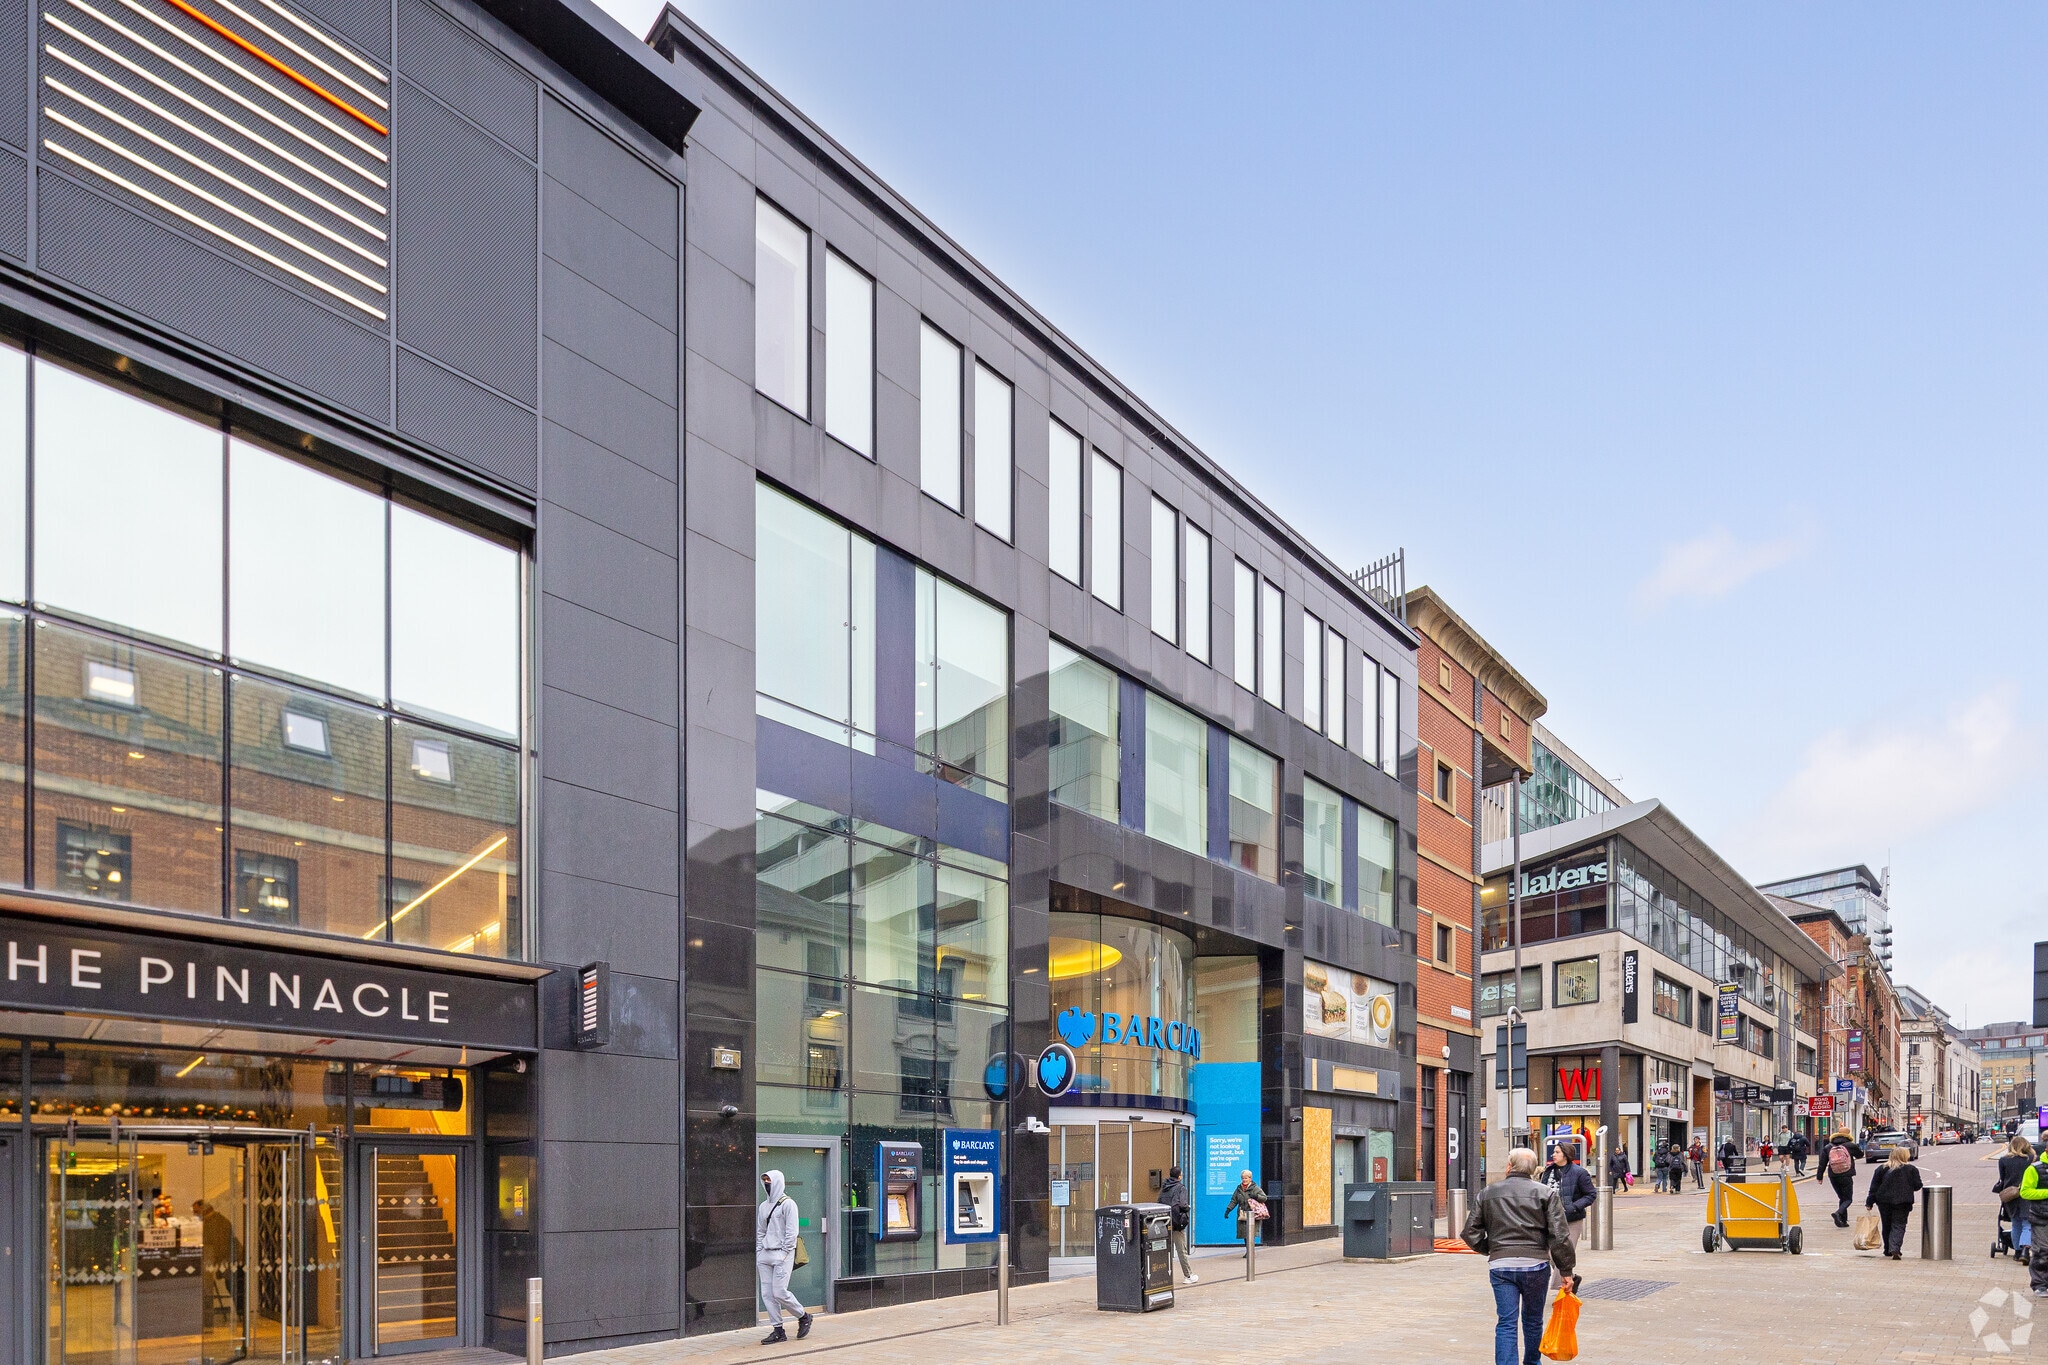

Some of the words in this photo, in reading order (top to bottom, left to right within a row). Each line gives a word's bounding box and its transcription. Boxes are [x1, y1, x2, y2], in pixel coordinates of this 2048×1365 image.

[1626, 955, 1636, 994] slaters
[140, 957, 449, 1024] PINNACLE
[1481, 982, 1516, 1001] ers
[1652, 1087, 1668, 1096] WR
[960, 1140, 994, 1150] BARCLAYS
[1449, 1128, 1459, 1159] B
